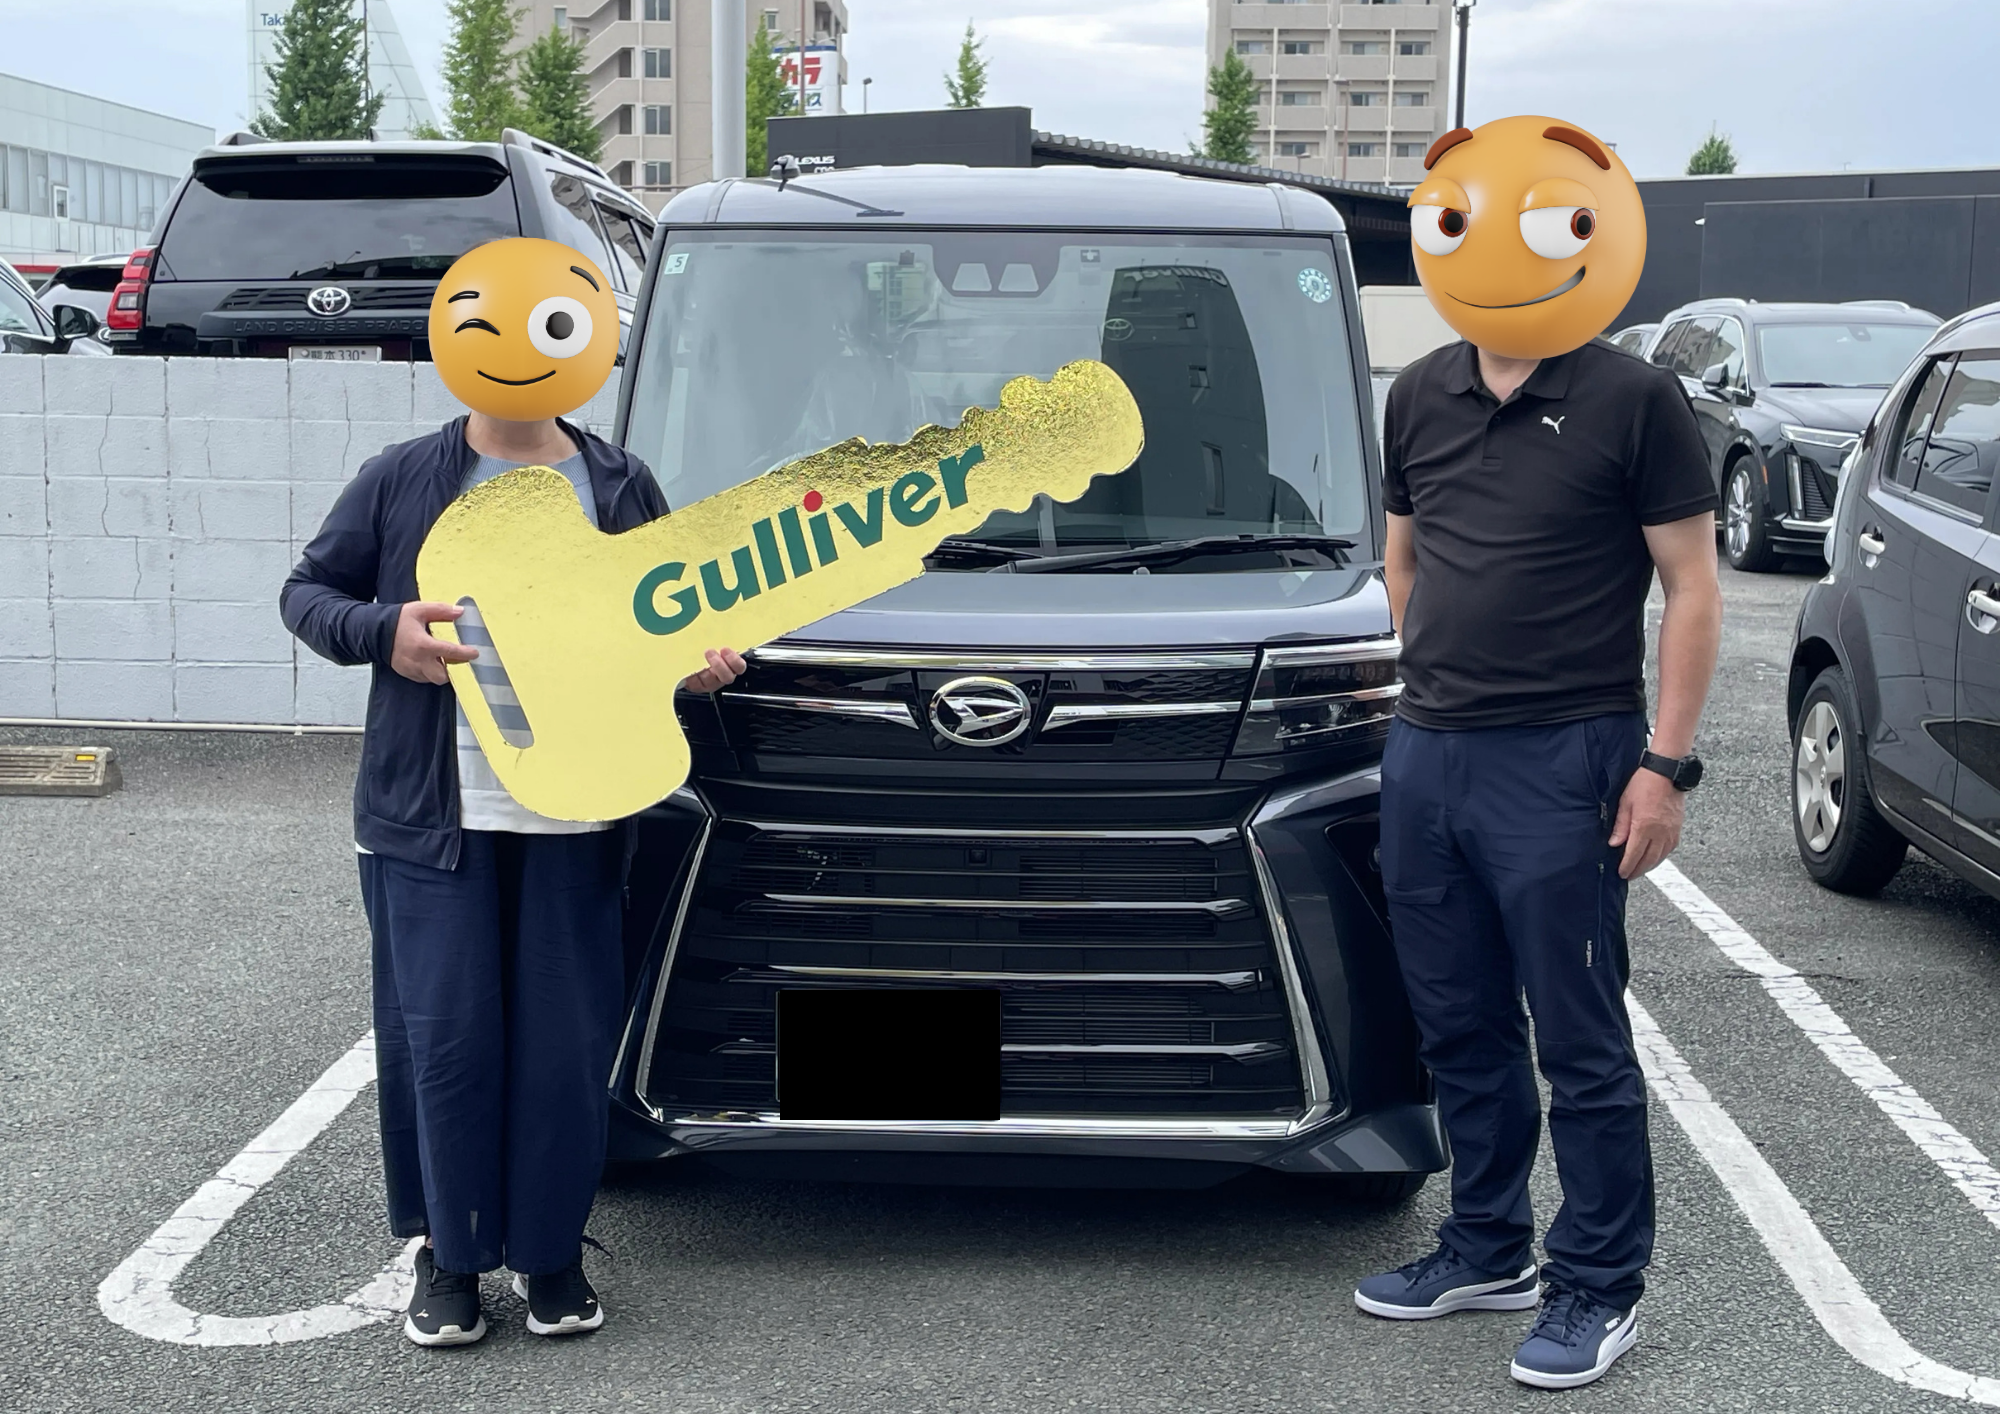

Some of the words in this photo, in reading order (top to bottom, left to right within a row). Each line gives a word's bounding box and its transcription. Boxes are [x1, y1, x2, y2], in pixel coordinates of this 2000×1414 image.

[233, 321, 278, 333] LAND
[282, 320, 359, 333] CRUISER
[364, 319, 426, 331] PRADO
[632, 443, 985, 636] Gulliver
